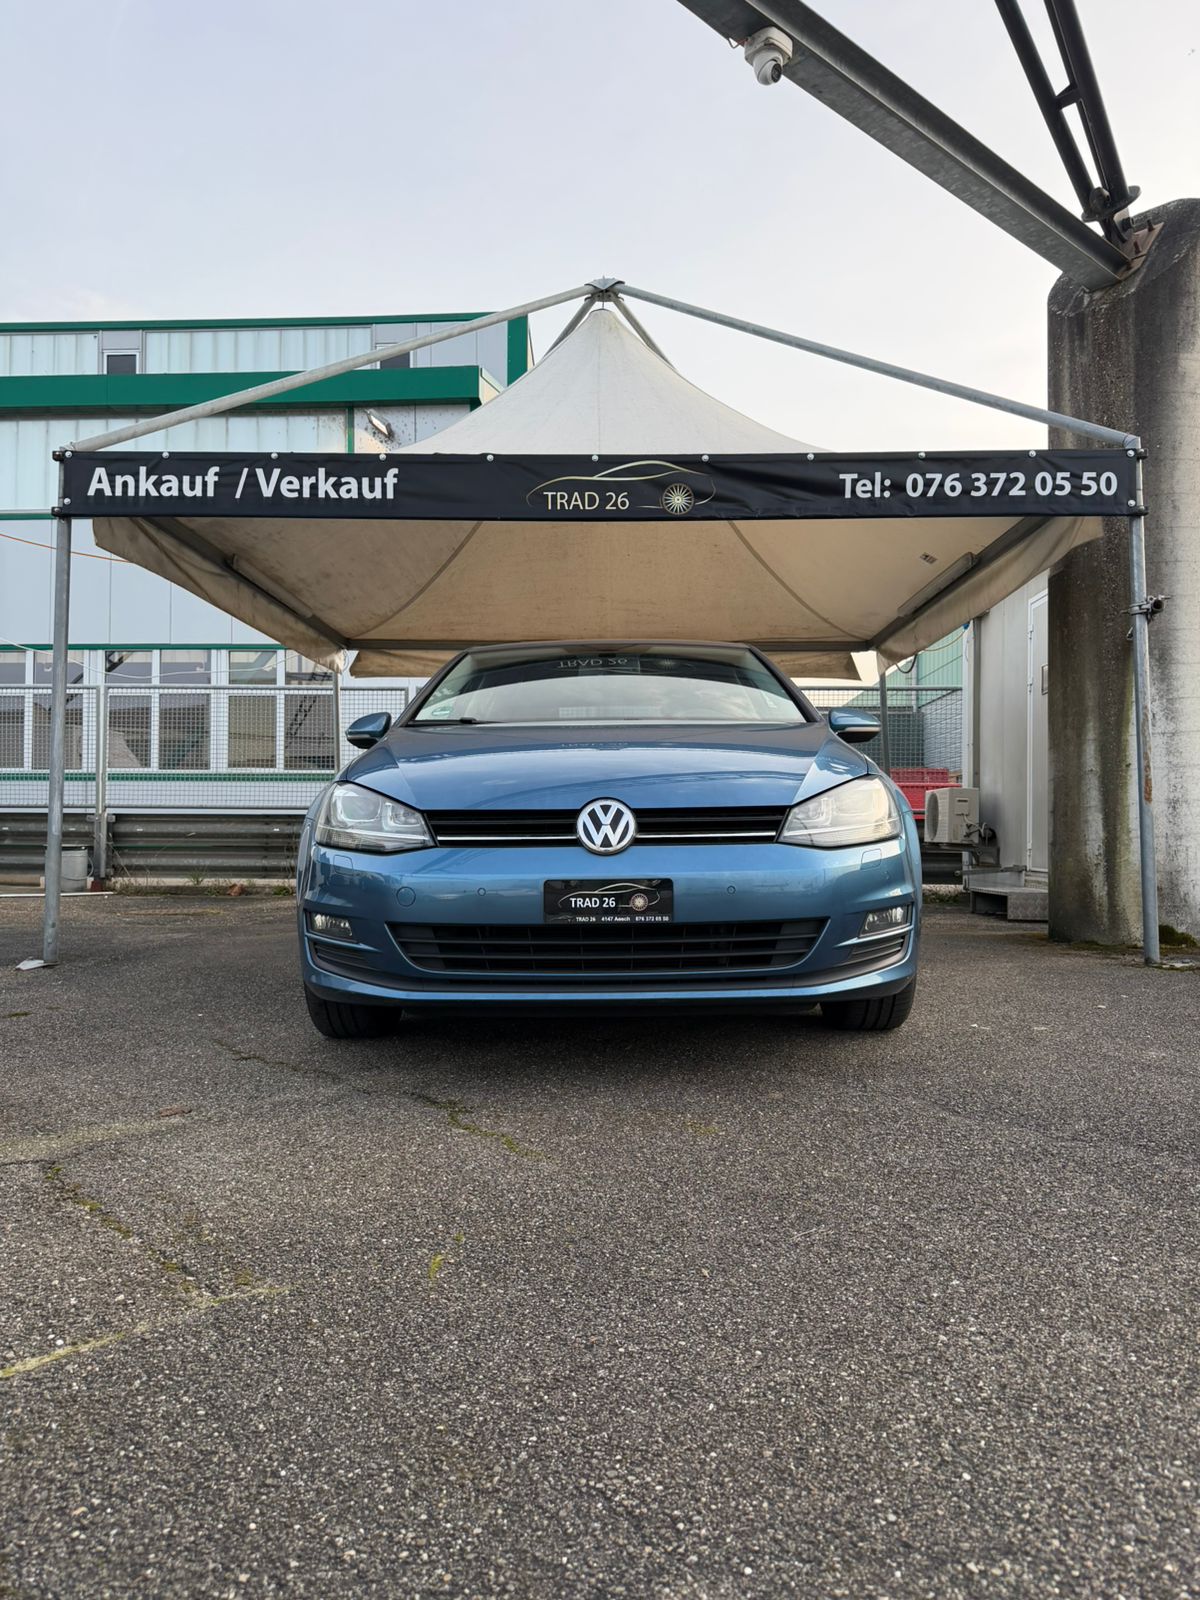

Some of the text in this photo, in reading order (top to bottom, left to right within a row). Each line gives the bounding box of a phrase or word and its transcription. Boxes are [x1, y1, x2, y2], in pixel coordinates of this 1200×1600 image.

[86, 466, 219, 498] Ankauf
[839, 471, 1118, 499] Tel: 076 372 05 50
[543, 491, 630, 510] TRAD 26
[580, 800, 632, 851] VW
[569, 896, 616, 908] TRAD 26
